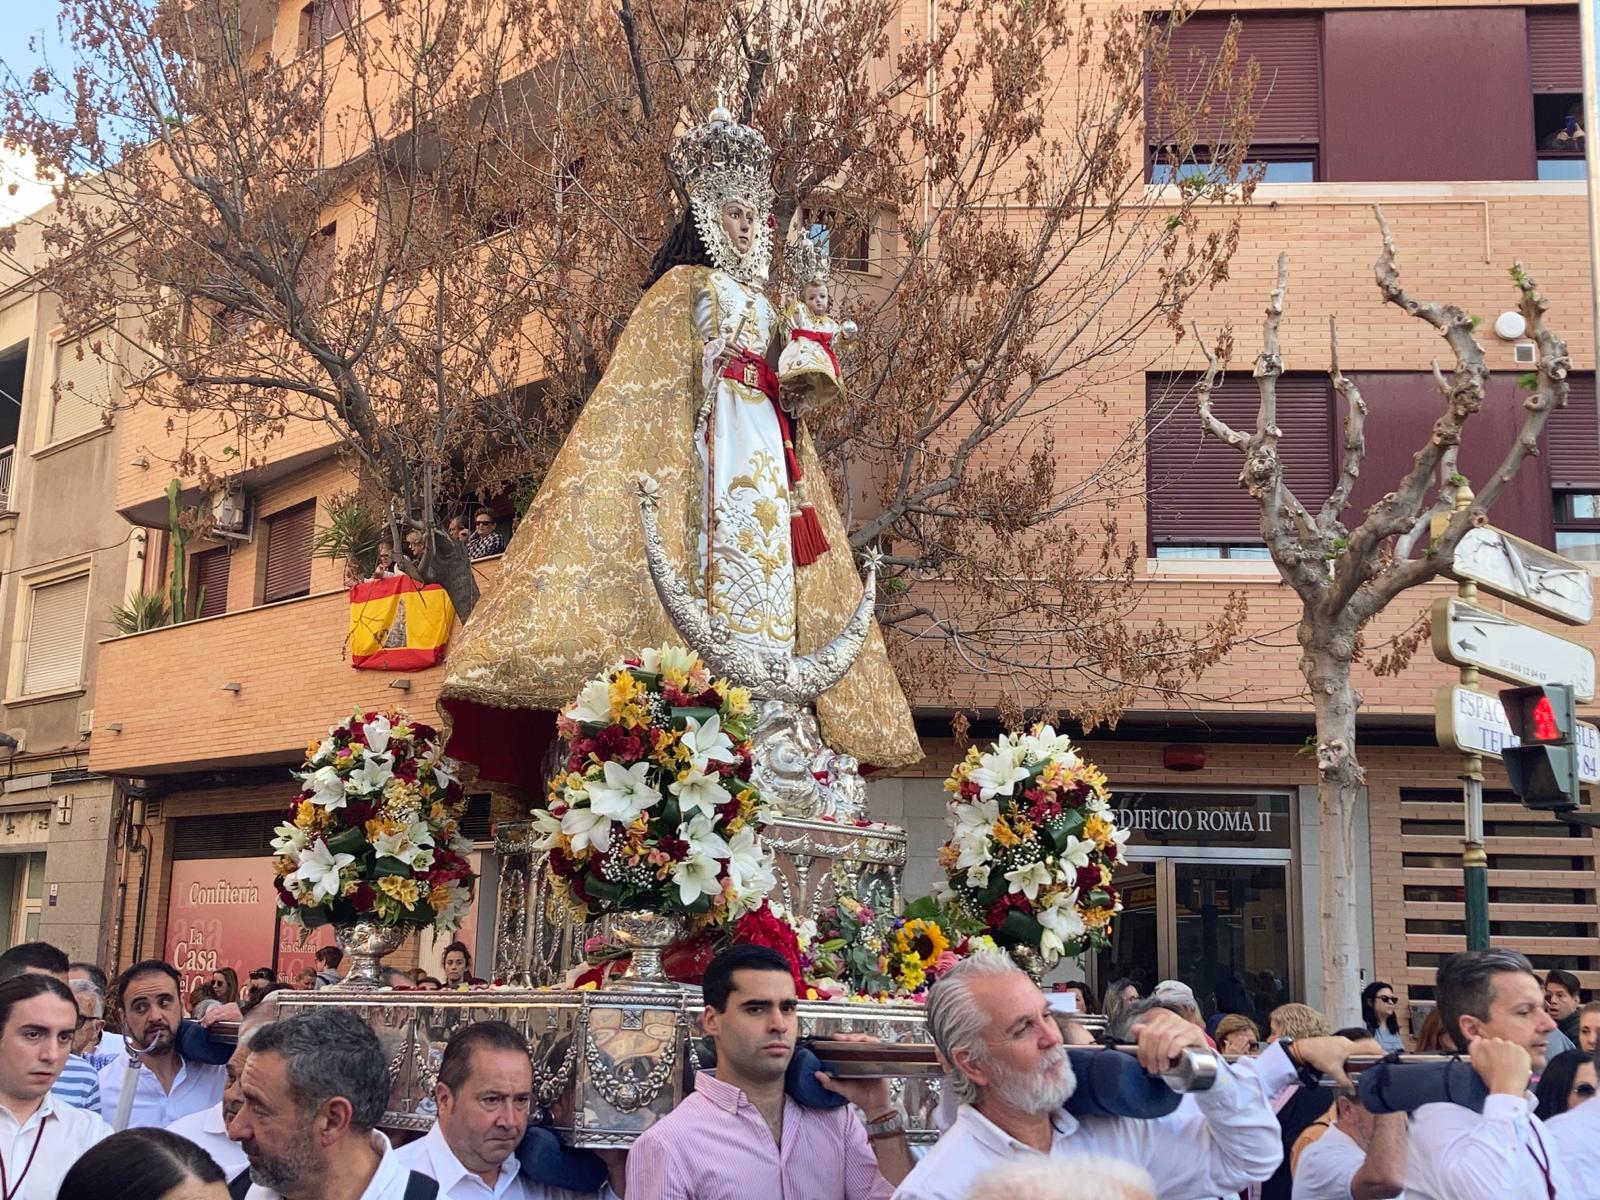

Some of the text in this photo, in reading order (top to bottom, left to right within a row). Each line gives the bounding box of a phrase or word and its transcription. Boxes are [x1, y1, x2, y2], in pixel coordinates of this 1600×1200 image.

[1460, 691, 1507, 724] ESPAC
[1479, 726, 1520, 753] TELE
[1109, 808, 1273, 832] EDIFICIO ROMA II
[189, 878, 260, 905] Confitería
[189, 927, 203, 945] La
[173, 941, 218, 971] Casa
